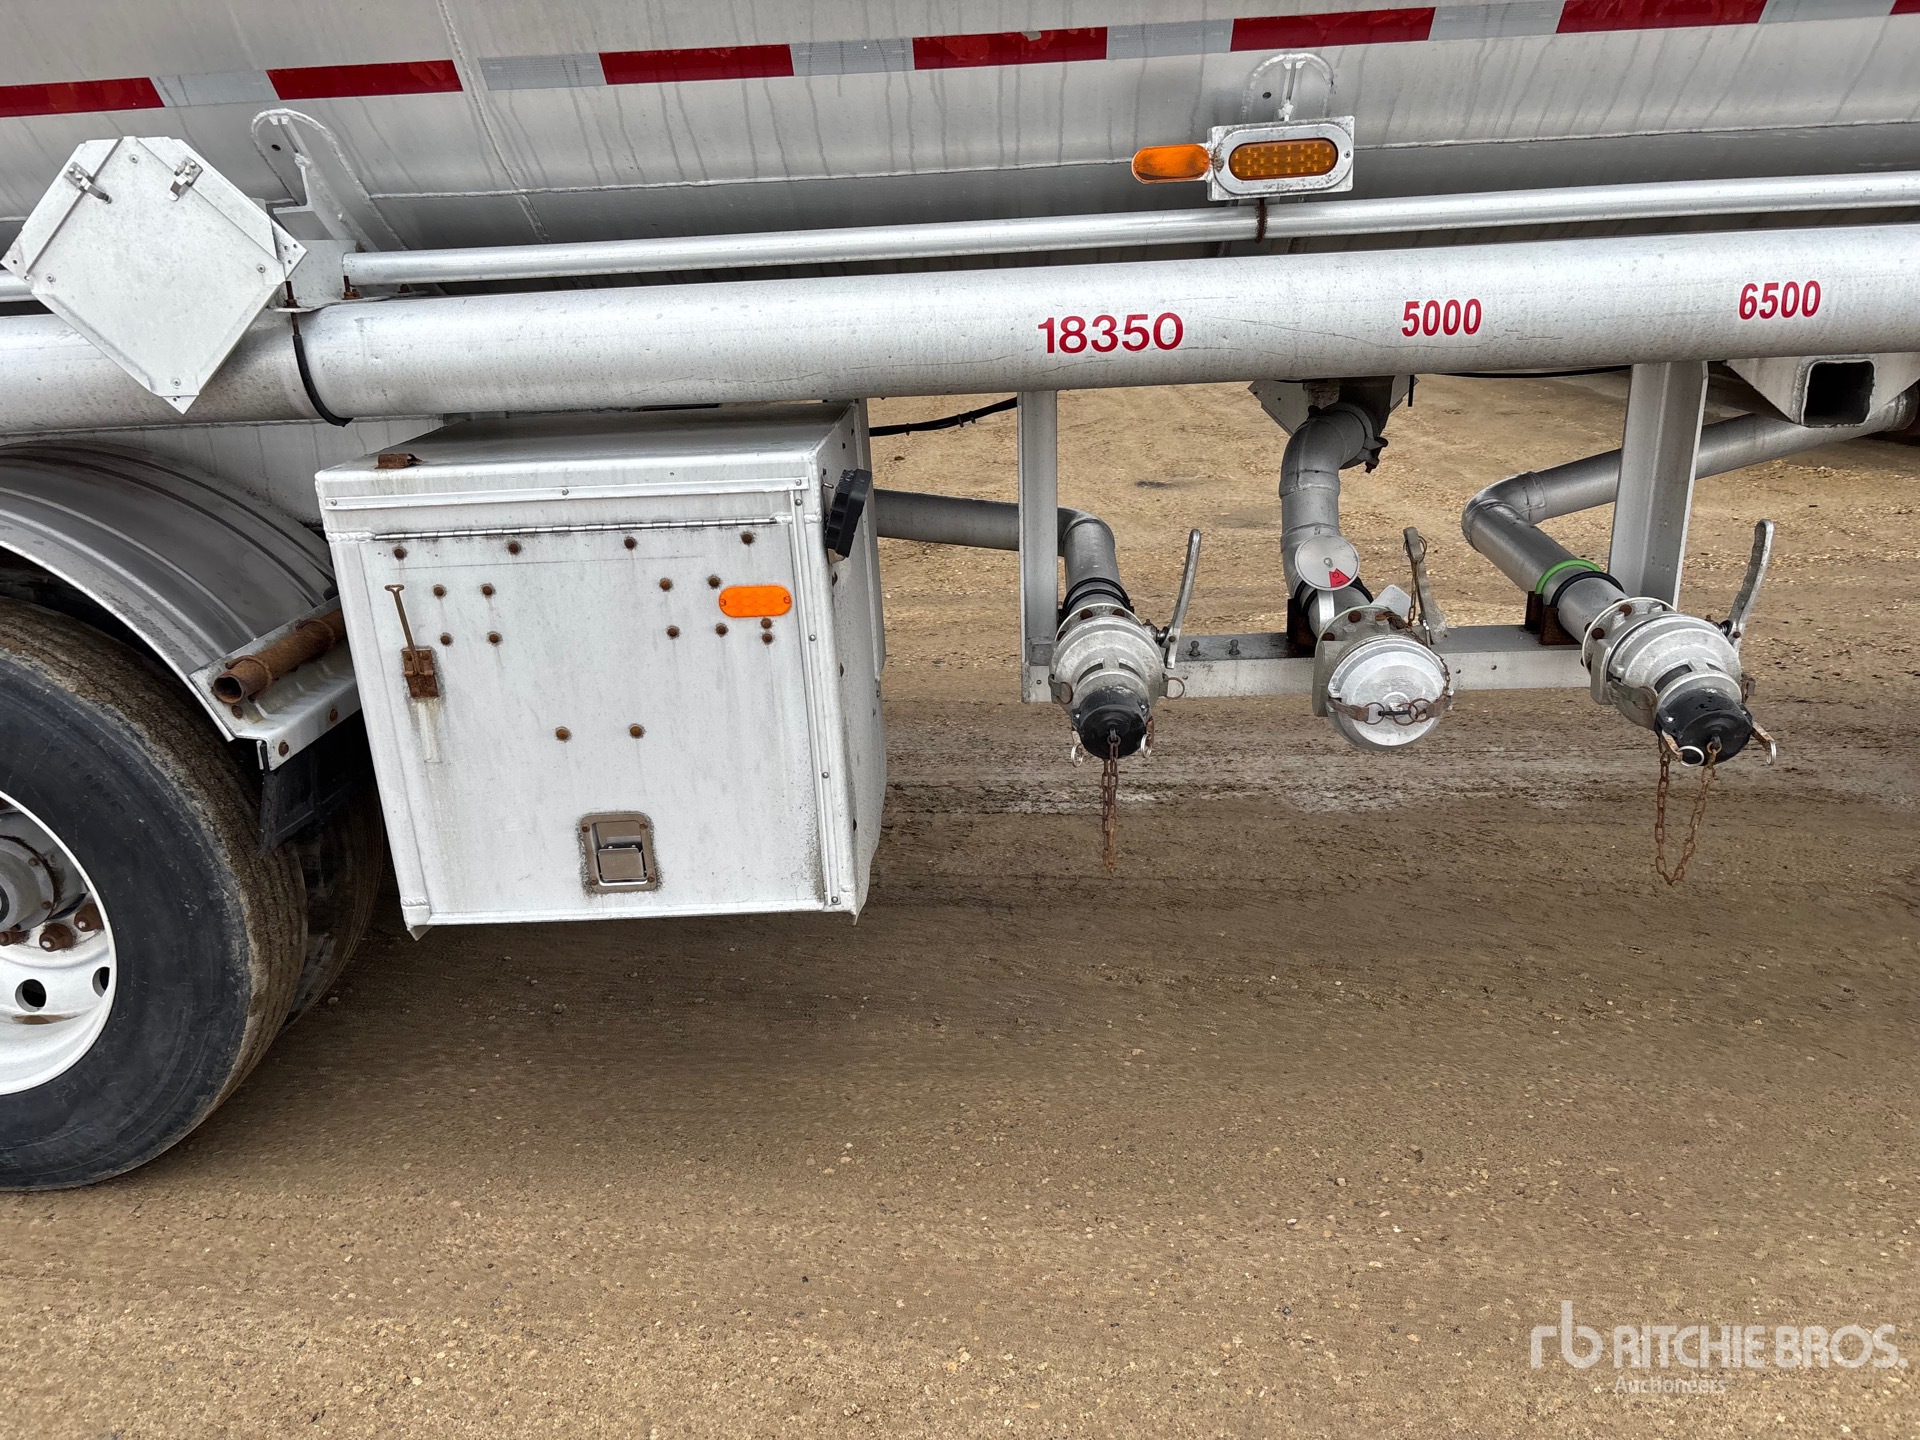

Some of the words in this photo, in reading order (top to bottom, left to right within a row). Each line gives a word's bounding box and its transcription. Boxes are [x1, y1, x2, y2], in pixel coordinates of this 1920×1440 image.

[1401, 298, 1482, 337] 5000
[1738, 280, 1821, 320] 6500
[1037, 311, 1184, 354] 18350
